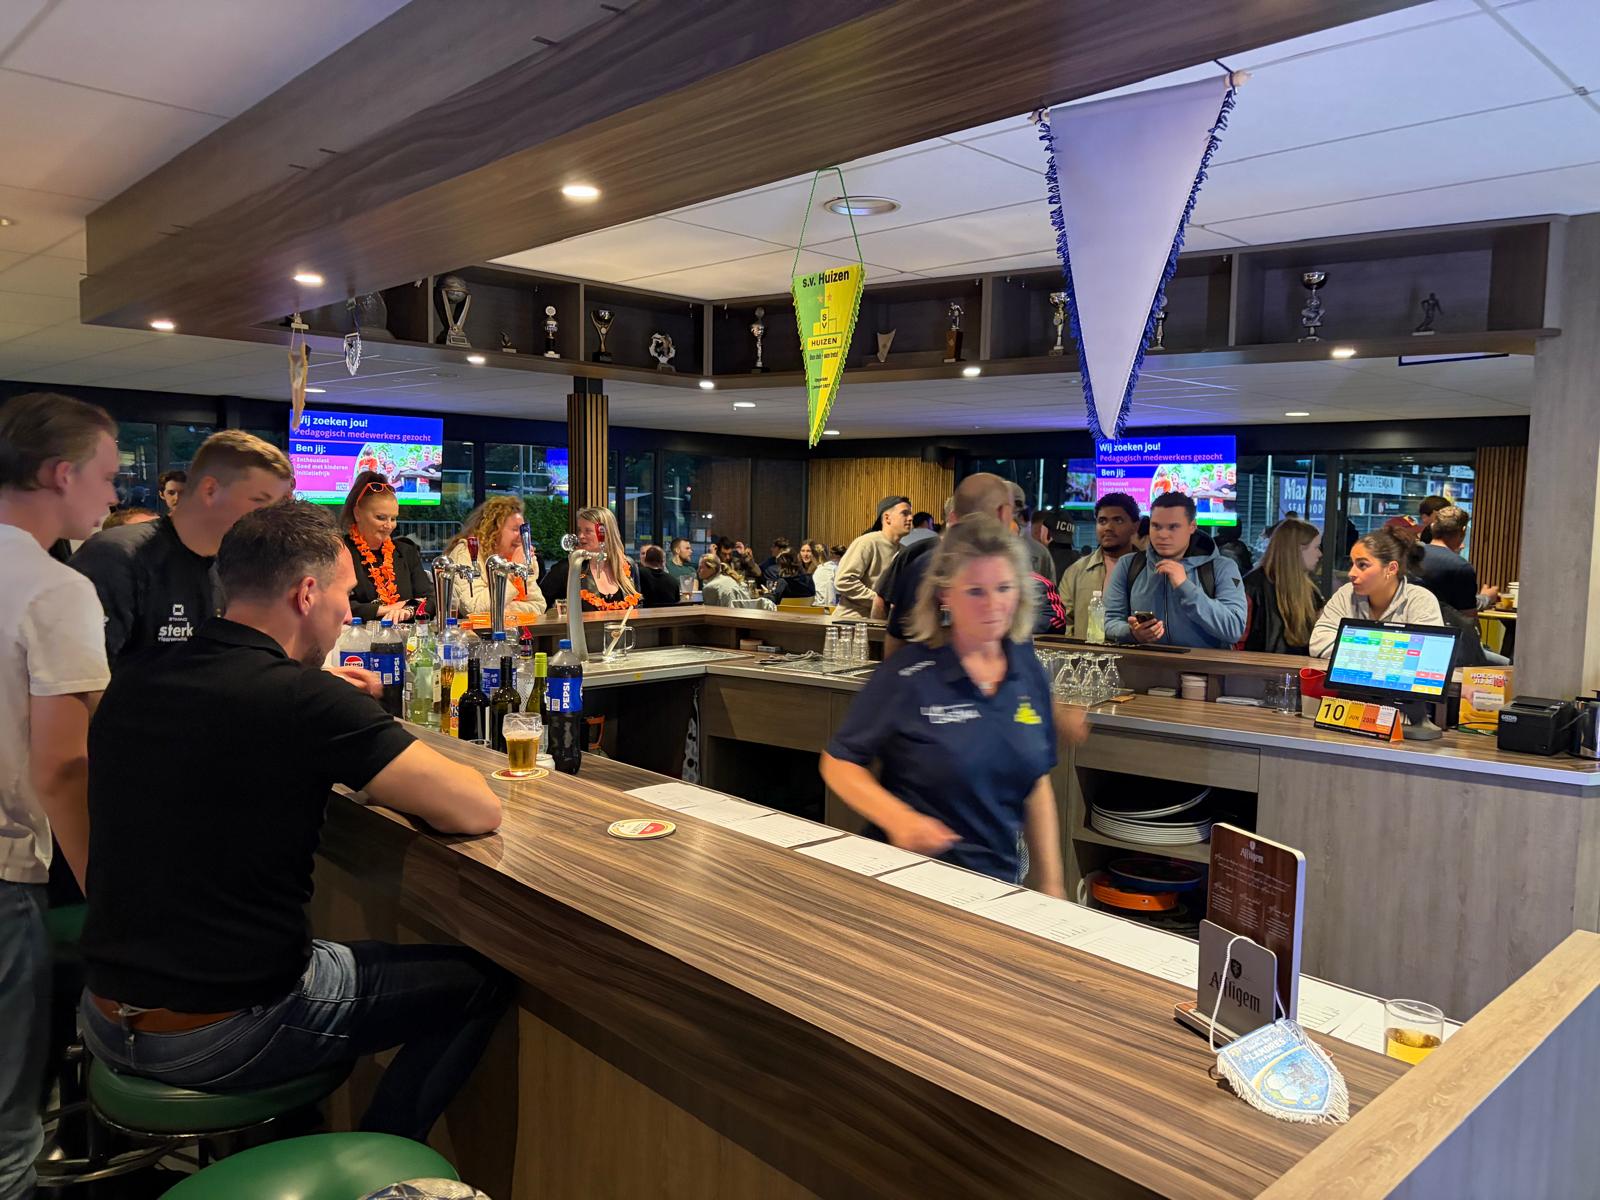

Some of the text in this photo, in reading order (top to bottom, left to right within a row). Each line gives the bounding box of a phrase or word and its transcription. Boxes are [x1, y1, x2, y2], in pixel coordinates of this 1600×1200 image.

[803, 269, 849, 288] s.v. Huizen
[811, 337, 838, 347] HUIZEN
[312, 416, 348, 427] zoeken
[350, 417, 368, 428] jou!
[295, 428, 431, 442] Pedagogisch medewerkers gezocht
[296, 443, 327, 455] Ben jij:
[1099, 442, 1161, 454] Wij zoeken jou!
[1099, 453, 1223, 463] Pedagogisch medewerkers gezocht
[1101, 468, 1126, 478] Ben jij:
[1284, 478, 1327, 500] Maxma
[1288, 502, 1324, 514] SEAFOD
[158, 622, 194, 637] sterk
[562, 682, 570, 709] PEPSI
[1323, 703, 1346, 722] 10
